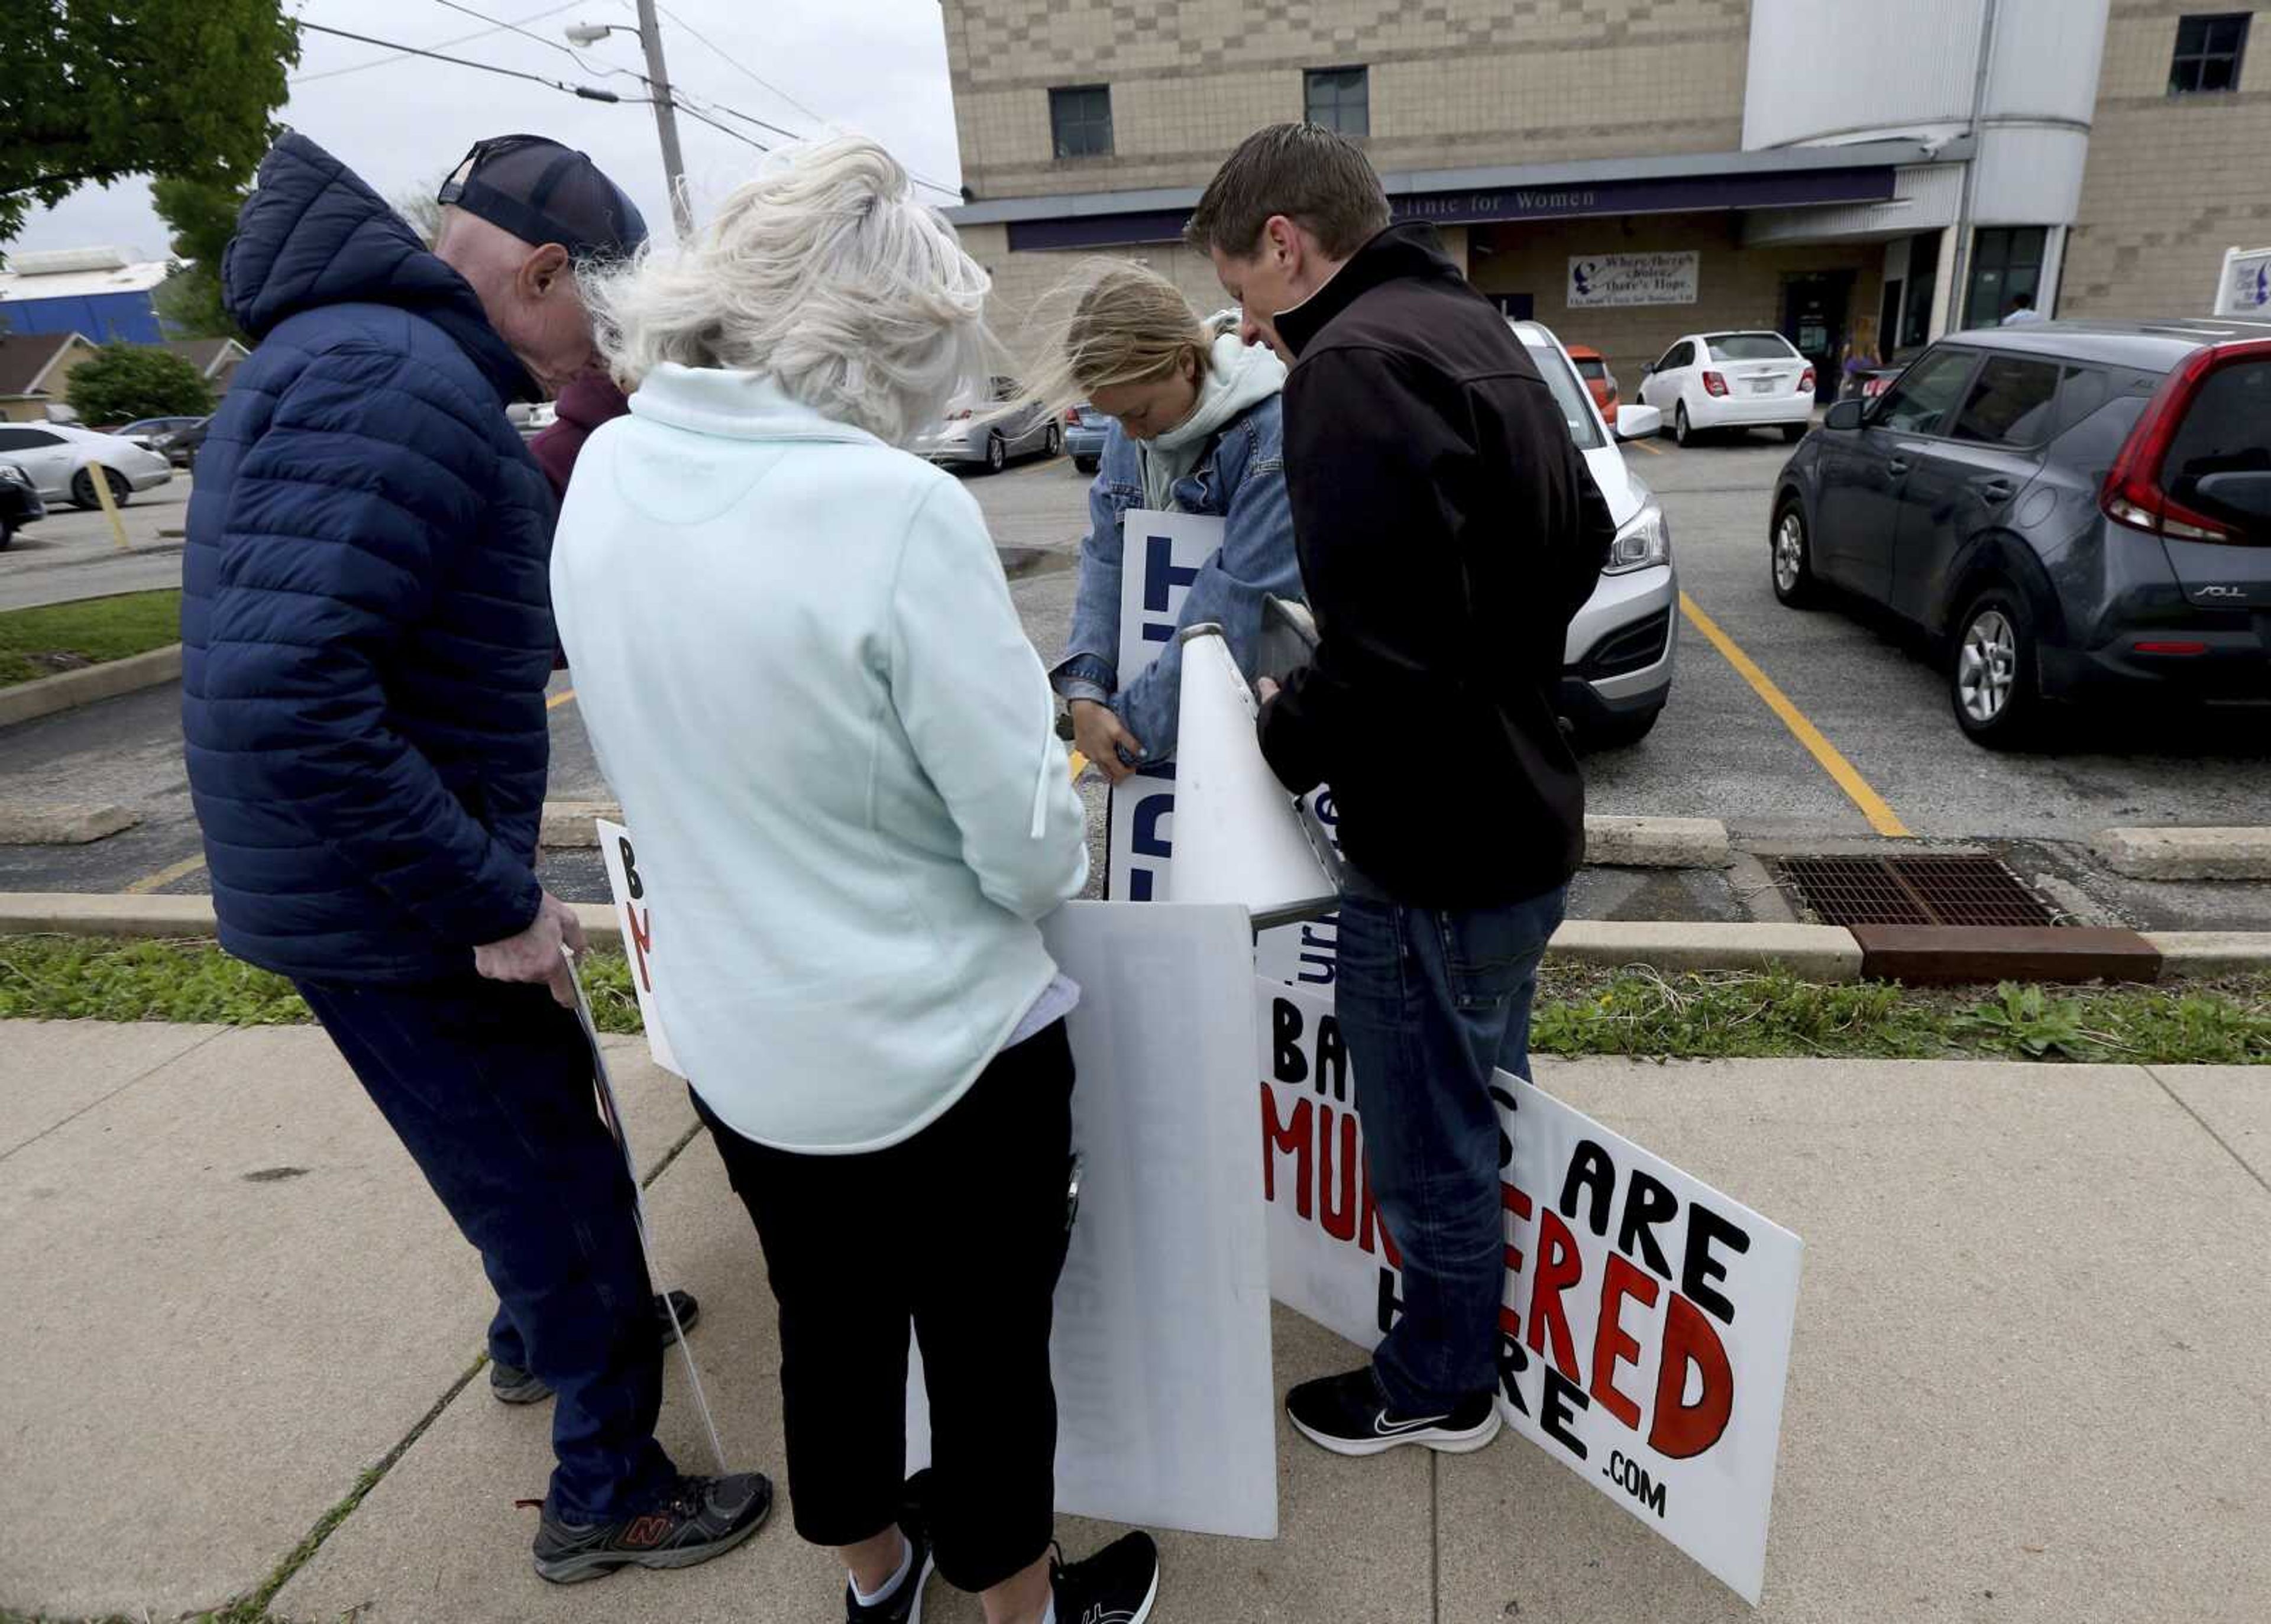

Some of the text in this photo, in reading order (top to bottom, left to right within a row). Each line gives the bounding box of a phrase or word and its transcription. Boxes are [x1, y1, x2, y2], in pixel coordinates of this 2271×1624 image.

[1470, 194, 1502, 212] for
[1516, 190, 1594, 209] Women
[1260, 1082, 1734, 1460] MURERED
[1560, 1139, 1751, 1325] ARE
[1602, 1450, 1667, 1518] .COM
